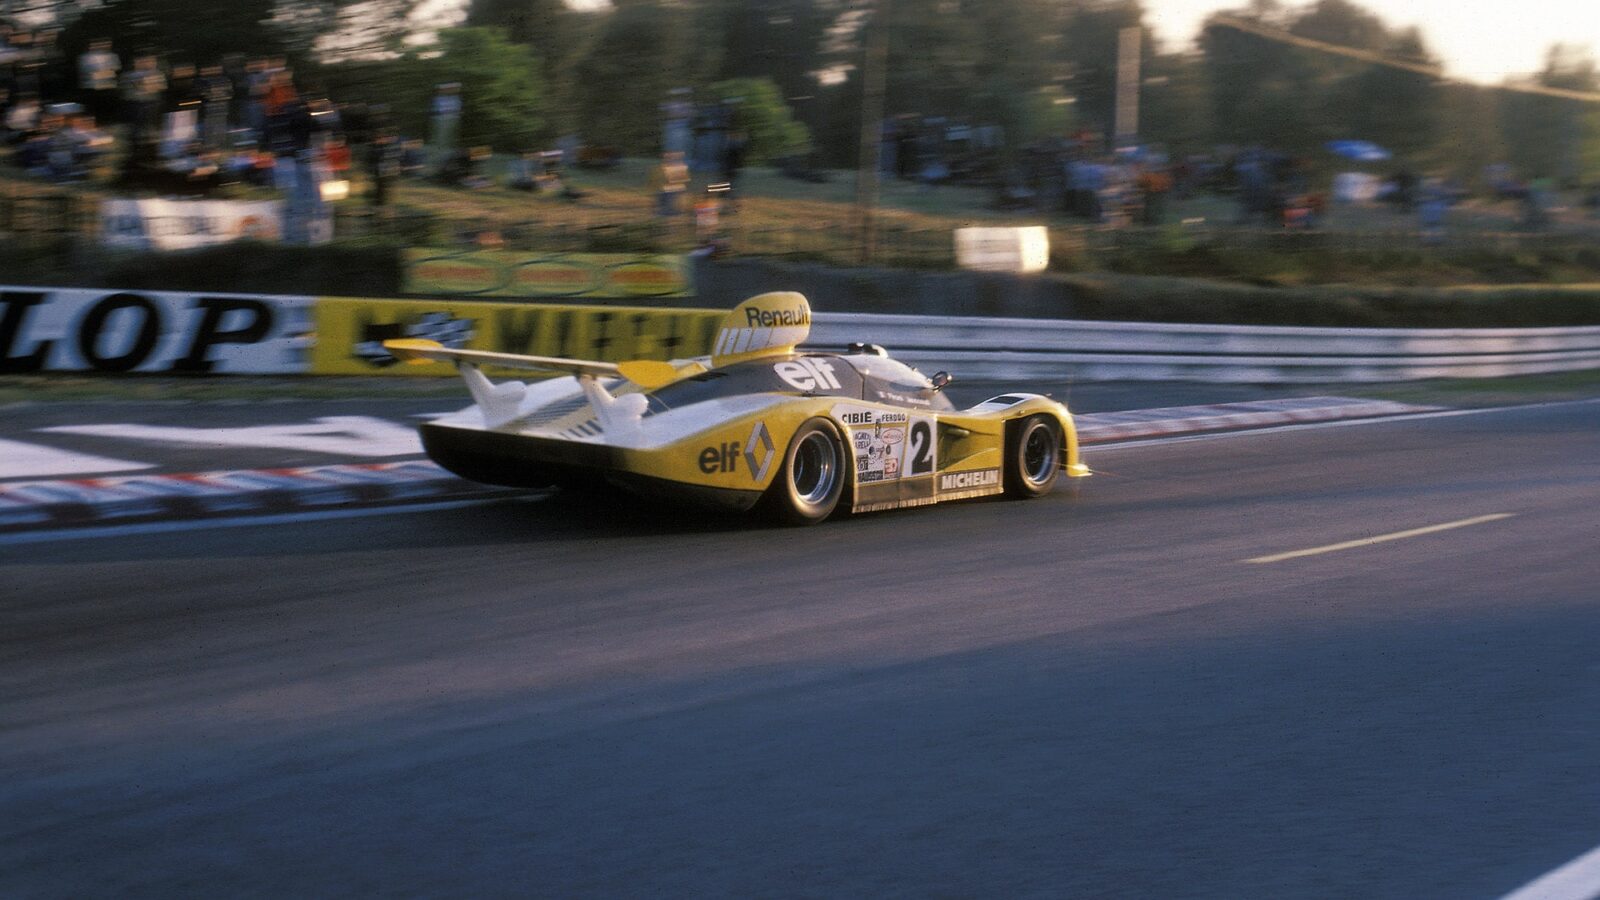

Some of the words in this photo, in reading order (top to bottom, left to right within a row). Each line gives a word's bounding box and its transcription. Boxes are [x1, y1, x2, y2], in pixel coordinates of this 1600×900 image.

[745, 306, 809, 327] Renault
[774, 357, 842, 390] elf
[699, 441, 740, 474] elf
[911, 421, 933, 474] 2
[942, 470, 998, 490] MICHELIN
